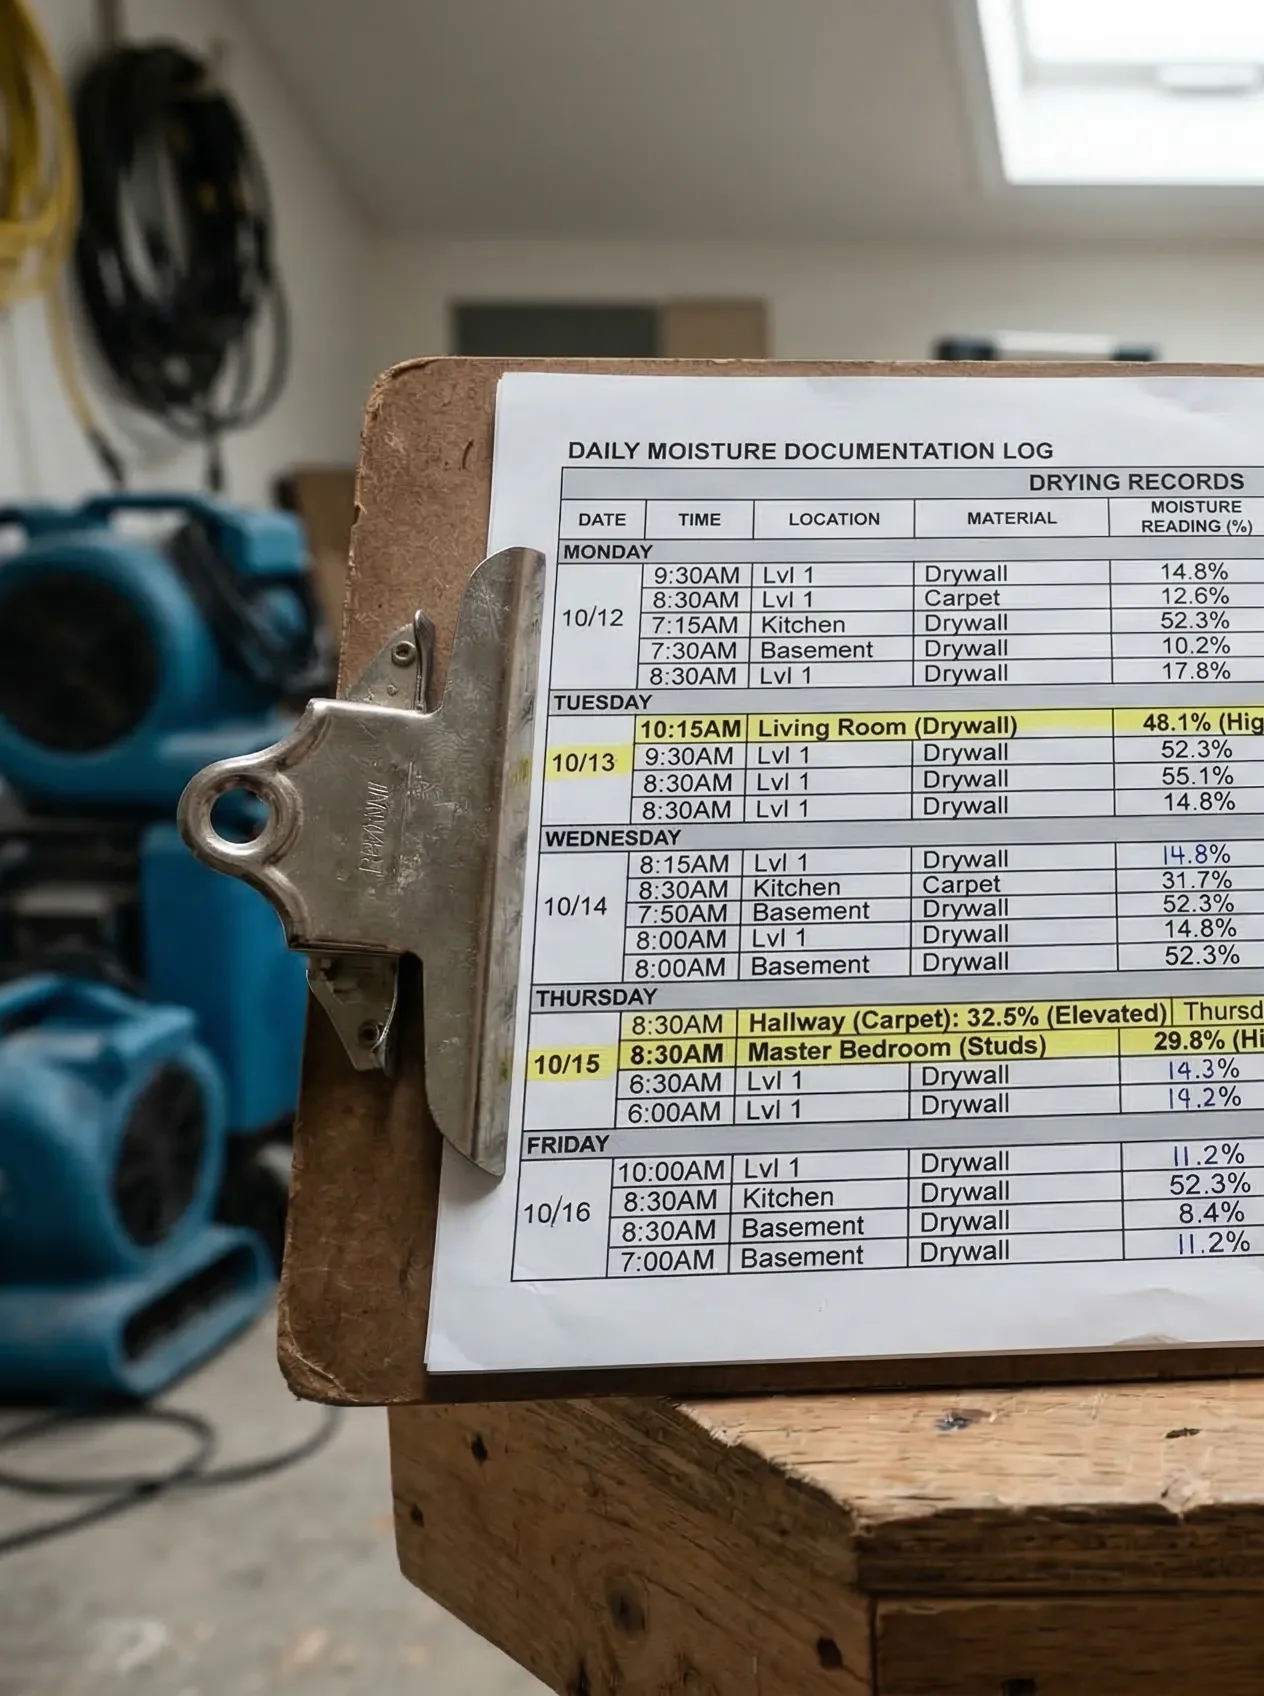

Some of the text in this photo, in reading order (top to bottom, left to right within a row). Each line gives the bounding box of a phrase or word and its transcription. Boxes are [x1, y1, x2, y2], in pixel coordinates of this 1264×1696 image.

[568, 441, 1054, 461] DAILY MOISTURE DOCUMENTATION LOG
[1029, 472, 1245, 492] DRYING RECORDS
[1151, 500, 1243, 514] MOISTURE
[578, 512, 627, 527] DATE
[677, 512, 722, 527] TIME
[788, 511, 880, 527] LOCATION
[967, 511, 1059, 526] MATERIAL
[1141, 519, 1253, 535] READING (%)
[563, 544, 654, 560] MONDAY
[654, 566, 740, 585] 9:30AM
[763, 565, 813, 585] Lvl 1
[925, 564, 1008, 585] Drywall
[1161, 561, 1229, 581] 14.8%
[652, 590, 739, 609] 8:30AM
[762, 590, 812, 609] Lvl 1
[924, 588, 1001, 609] Carpet
[1161, 585, 1230, 605] 12.6%
[562, 604, 624, 628] 10/12
[651, 615, 739, 635] 7:15AM
[761, 615, 846, 635] Kitchen
[924, 612, 1008, 634] Drywall
[1160, 610, 1231, 630] 52.3%
[651, 641, 737, 661] 7:30AM
[760, 640, 874, 660] Basement
[924, 638, 1008, 659] Drywall
[1162, 635, 1231, 655] 10.2%
[649, 666, 737, 686] 8:30AM
[760, 665, 811, 685] Lvl 1
[924, 663, 1008, 685] Drywall
[1162, 660, 1231, 680] 17.8%
[553, 693, 654, 711] TUESDAY
[640, 719, 741, 739] 10:15AM
[758, 715, 1018, 740] Living Room (Drywall)
[1142, 711, 1212, 732] 48.1%
[645, 746, 734, 767] 9:30AM
[757, 745, 809, 765] Lvl 1
[923, 741, 1009, 764] Drywall
[1161, 738, 1233, 759] 52.3%
[552, 752, 616, 773] 10/13
[643, 772, 733, 794] 8:30AM
[756, 771, 808, 792] Lvl 1
[923, 768, 1009, 791] Drywall
[1161, 764, 1235, 786] 55.1%
[642, 799, 732, 821] 8:30AM
[756, 798, 808, 819] Lvl 1
[923, 795, 1009, 818] Drywall
[1163, 790, 1236, 812] 14.8%
[544, 828, 682, 848] WEDNESDAY
[639, 853, 729, 875] 8:15AM
[754, 852, 807, 873] Lvl 1
[923, 848, 1009, 871] Drywall
[1163, 843, 1231, 866] 14.8%
[638, 879, 729, 901] 8:30AM
[753, 877, 841, 898] Kitchen
[922, 874, 1002, 895] Carpet
[1161, 869, 1233, 890] 31.7%
[544, 894, 608, 917] 10/14
[637, 903, 728, 925] 7:50AM
[753, 901, 871, 922] Basement
[923, 897, 1009, 919] Drywall
[1163, 892, 1235, 914] 52.3%
[752, 927, 805, 948] Lvl 1
[923, 923, 1009, 946] Drywall
[1164, 917, 1238, 939] 14.8%
[636, 928, 727, 951] 8:00AM
[751, 954, 871, 976] Basement
[922, 950, 1009, 974] Drywall
[1165, 943, 1241, 966] 52.3%
[634, 956, 726, 979] 8:00AM
[535, 987, 659, 1008] THURSDAY
[631, 1013, 723, 1036] 8:30AM
[749, 1002, 1168, 1034] Hallway (Carpet): 32.5% (Elevated)
[748, 1033, 1047, 1063] Master Bedroom (Studs)
[1153, 1029, 1226, 1052] 29.8%
[533, 1053, 601, 1075] 10/15
[629, 1042, 724, 1066] 8:30AM
[921, 1063, 1010, 1088] Drywall
[1169, 1056, 1240, 1081] 14.3%
[629, 1071, 722, 1095] 6:30AM
[747, 1069, 801, 1092] Lvl 1
[627, 1100, 721, 1124] 6:00AM
[746, 1098, 801, 1121] Lvl 1
[921, 1091, 1009, 1117] Drywall
[526, 1134, 611, 1155] FRIDAY
[1173, 1142, 1245, 1168] 11.2%
[618, 1159, 725, 1183] 10:00AM
[744, 1156, 799, 1179] Lvl 1
[921, 1150, 1010, 1175] Drywall
[920, 1179, 1010, 1205] Drywall
[1169, 1171, 1252, 1196] 52.3%
[623, 1188, 718, 1213] 8:30AM
[743, 1186, 834, 1209] Kitchen
[523, 1194, 591, 1229] 10/16
[920, 1209, 1010, 1234] Drywall
[1178, 1199, 1246, 1225] 8.4%
[621, 1218, 716, 1243] 8:30AM
[741, 1215, 865, 1239] Basement
[920, 1238, 1010, 1264] Drywall
[1178, 1229, 1251, 1256] 11.2%
[620, 1248, 715, 1273] 7:00AM
[740, 1244, 864, 1269] Basement
